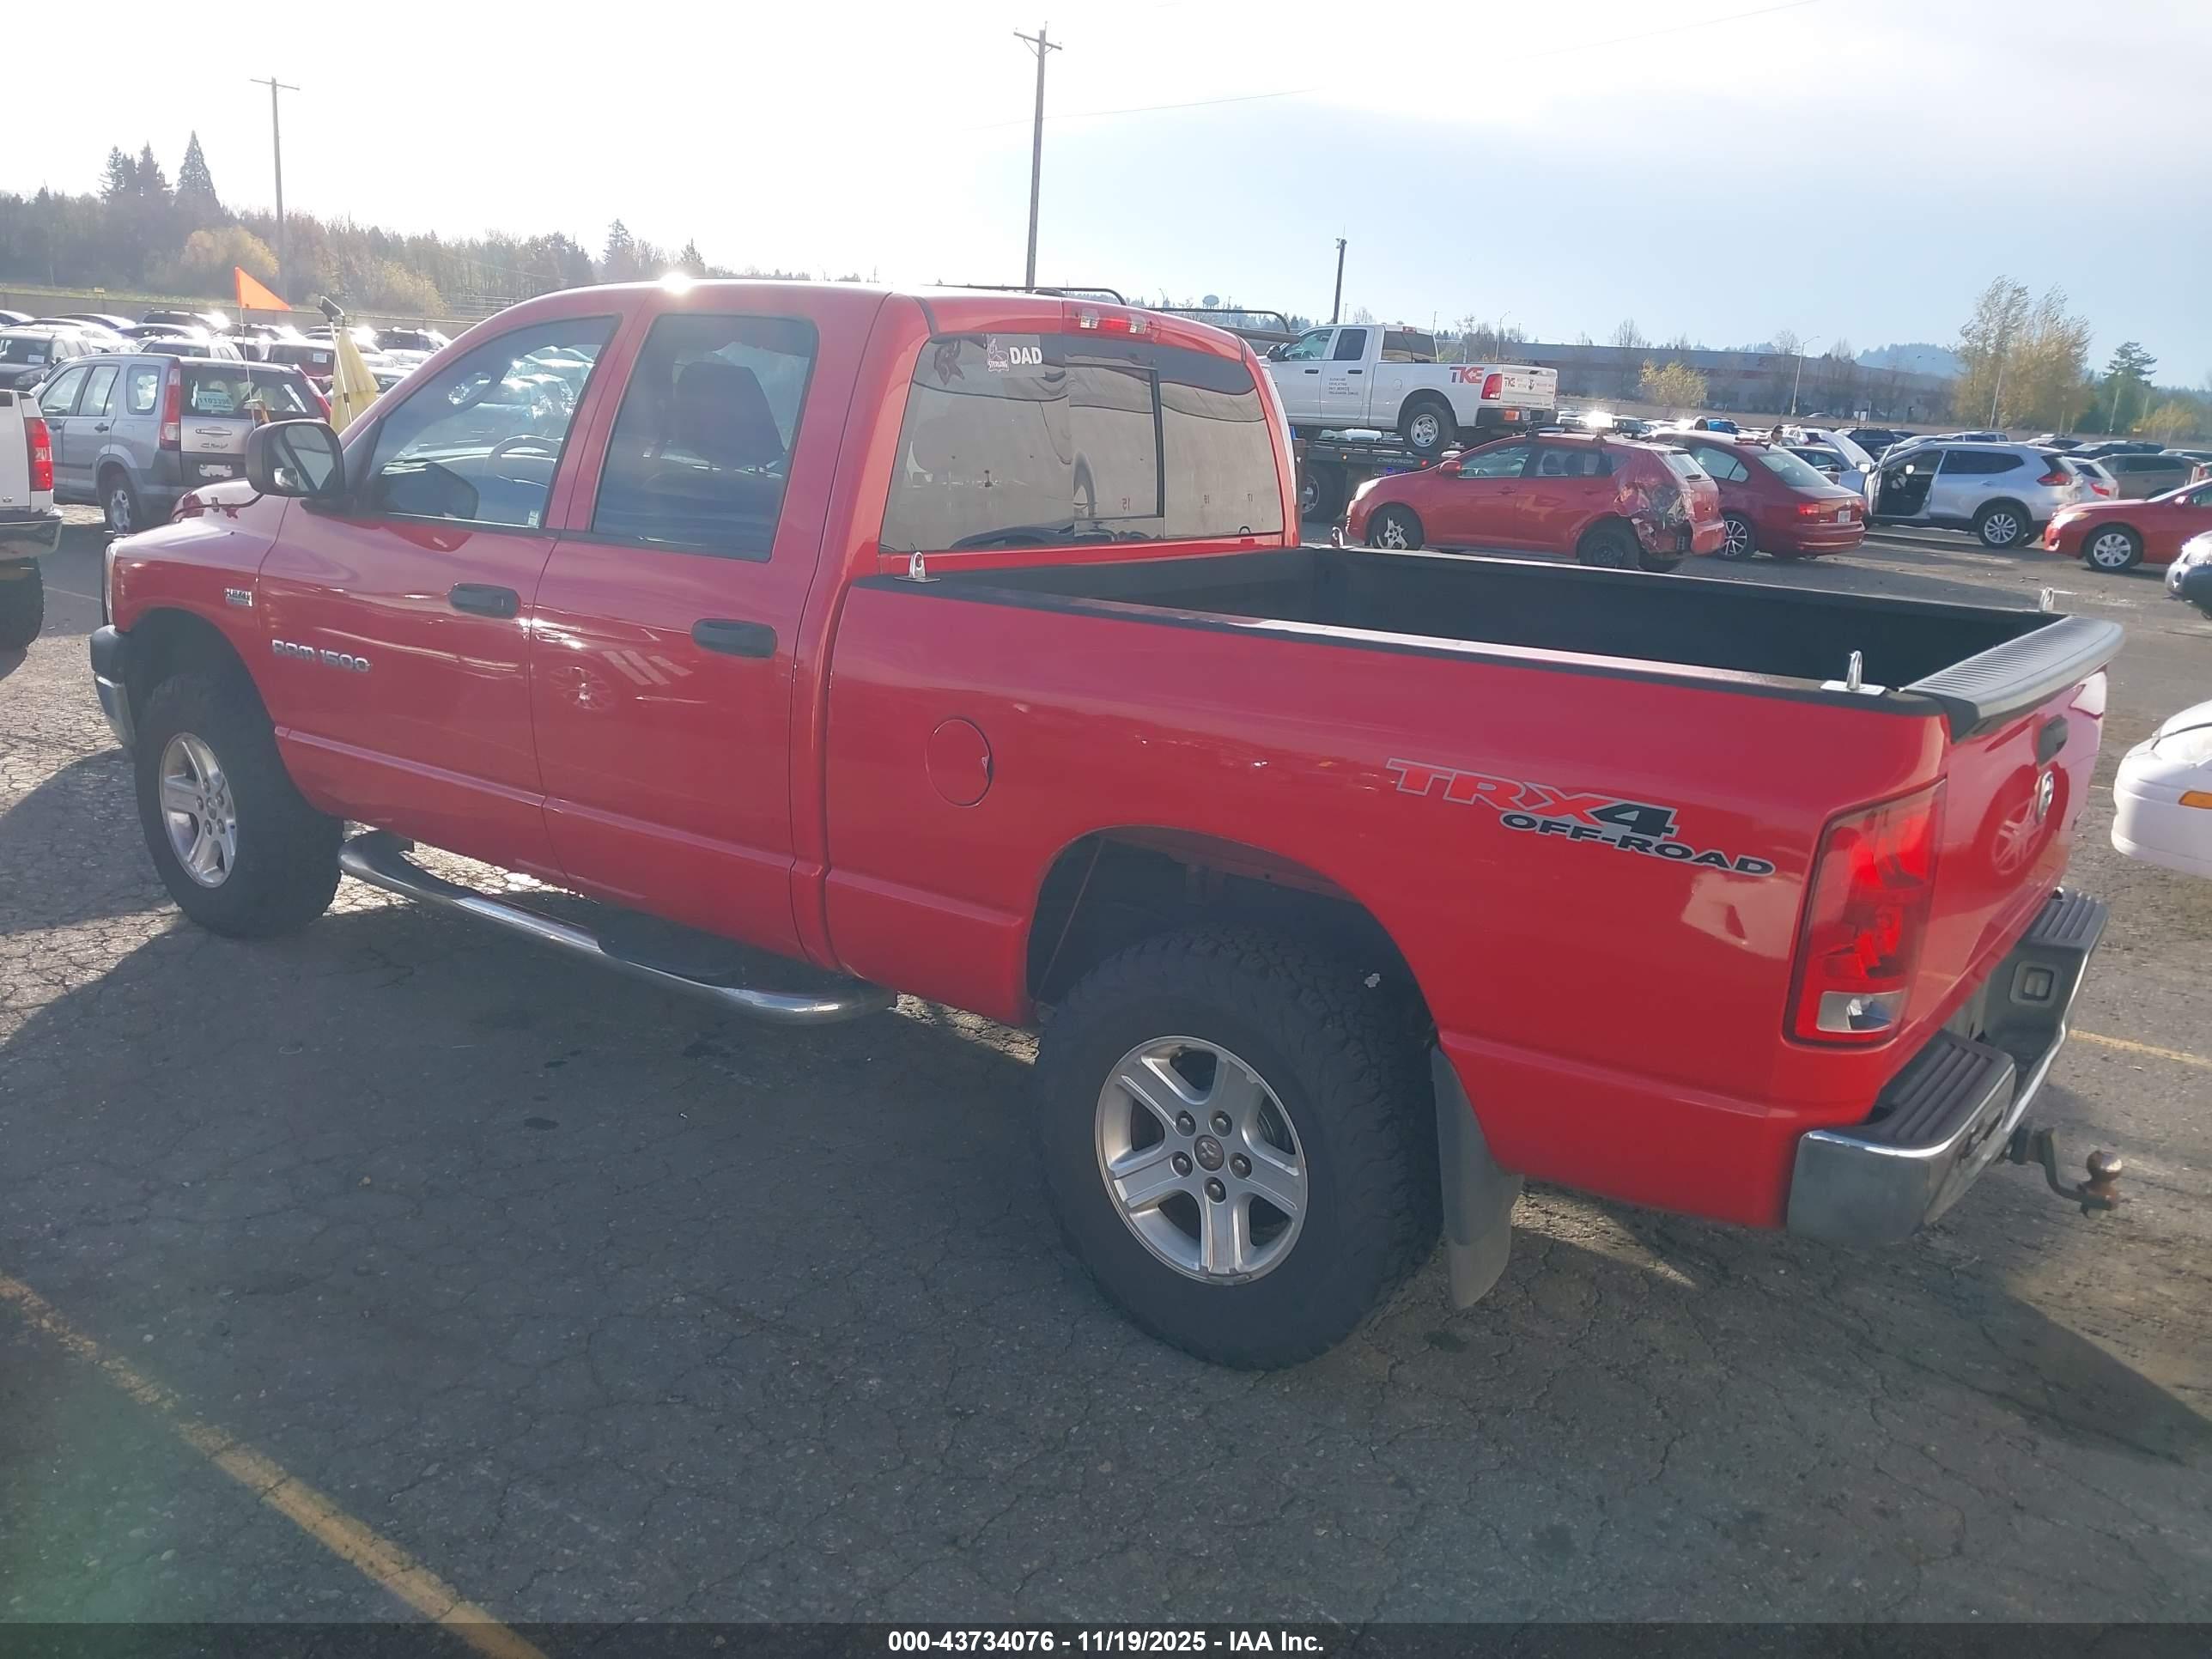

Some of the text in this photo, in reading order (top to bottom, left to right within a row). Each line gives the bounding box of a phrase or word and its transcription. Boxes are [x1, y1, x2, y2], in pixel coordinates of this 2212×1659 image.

[1009, 346, 1042, 365] DAD
[1449, 366, 1485, 384] TKE
[271, 639, 371, 672] RAM 1500
[1386, 757, 1679, 839] TRX4
[1501, 811, 1775, 877] OFF-ROAD
